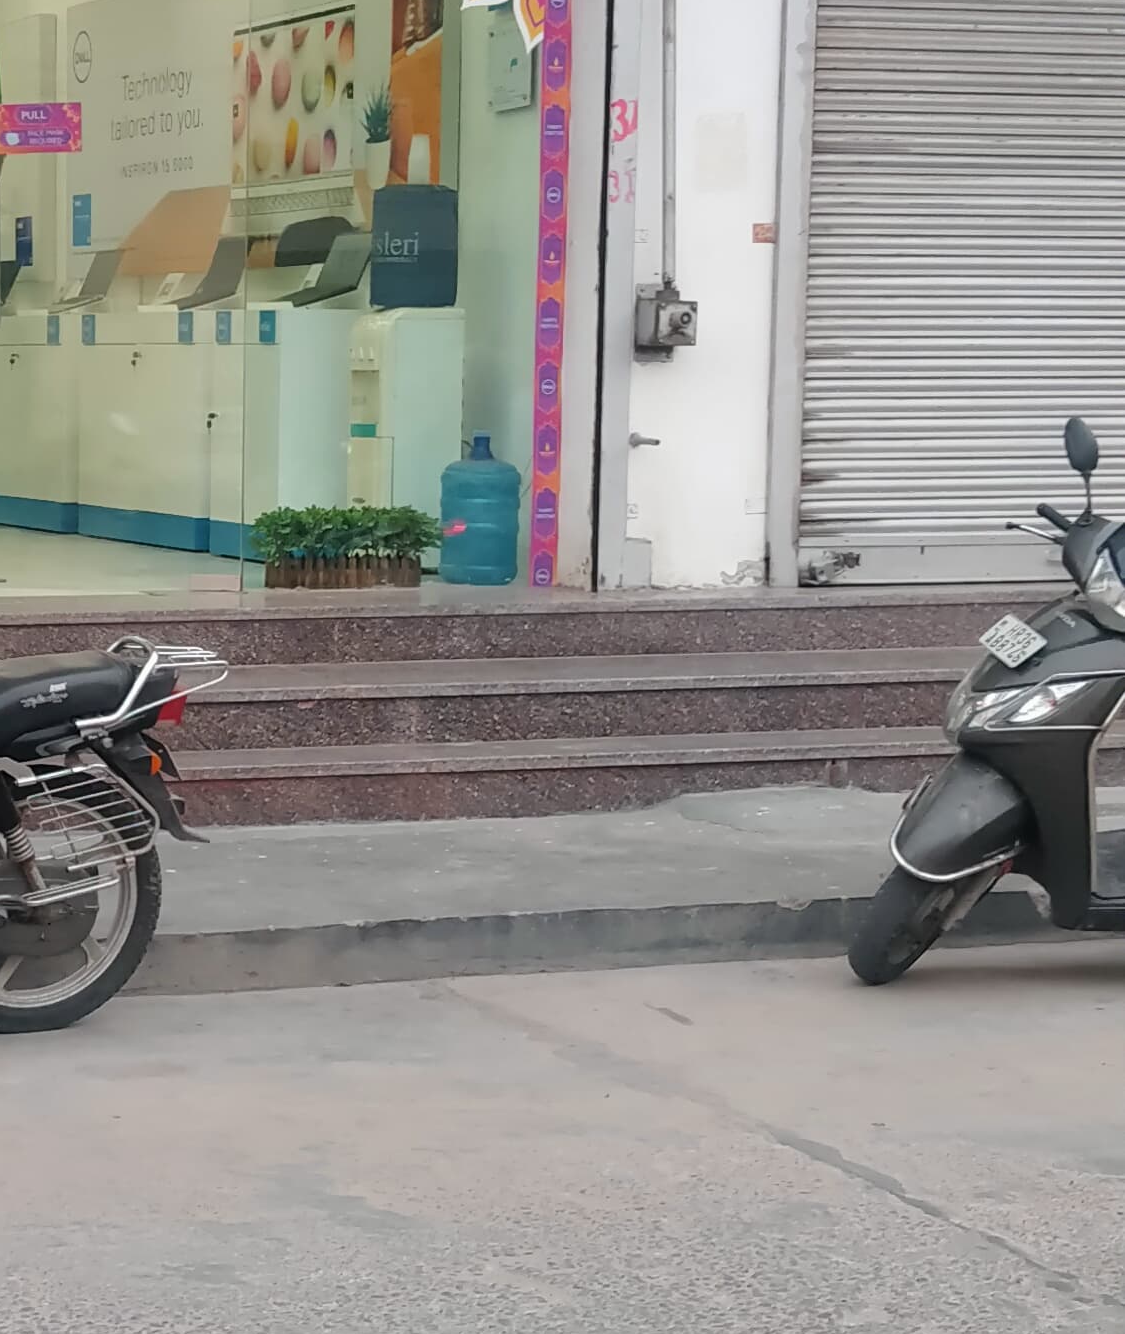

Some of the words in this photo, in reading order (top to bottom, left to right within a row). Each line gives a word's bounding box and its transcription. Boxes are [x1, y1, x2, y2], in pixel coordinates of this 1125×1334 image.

[122, 67, 193, 100] Technology
[21, 111, 47, 121] PULL
[111, 110, 156, 142] tailored
[160, 112, 173, 134] to
[177, 108, 204, 136] you.
